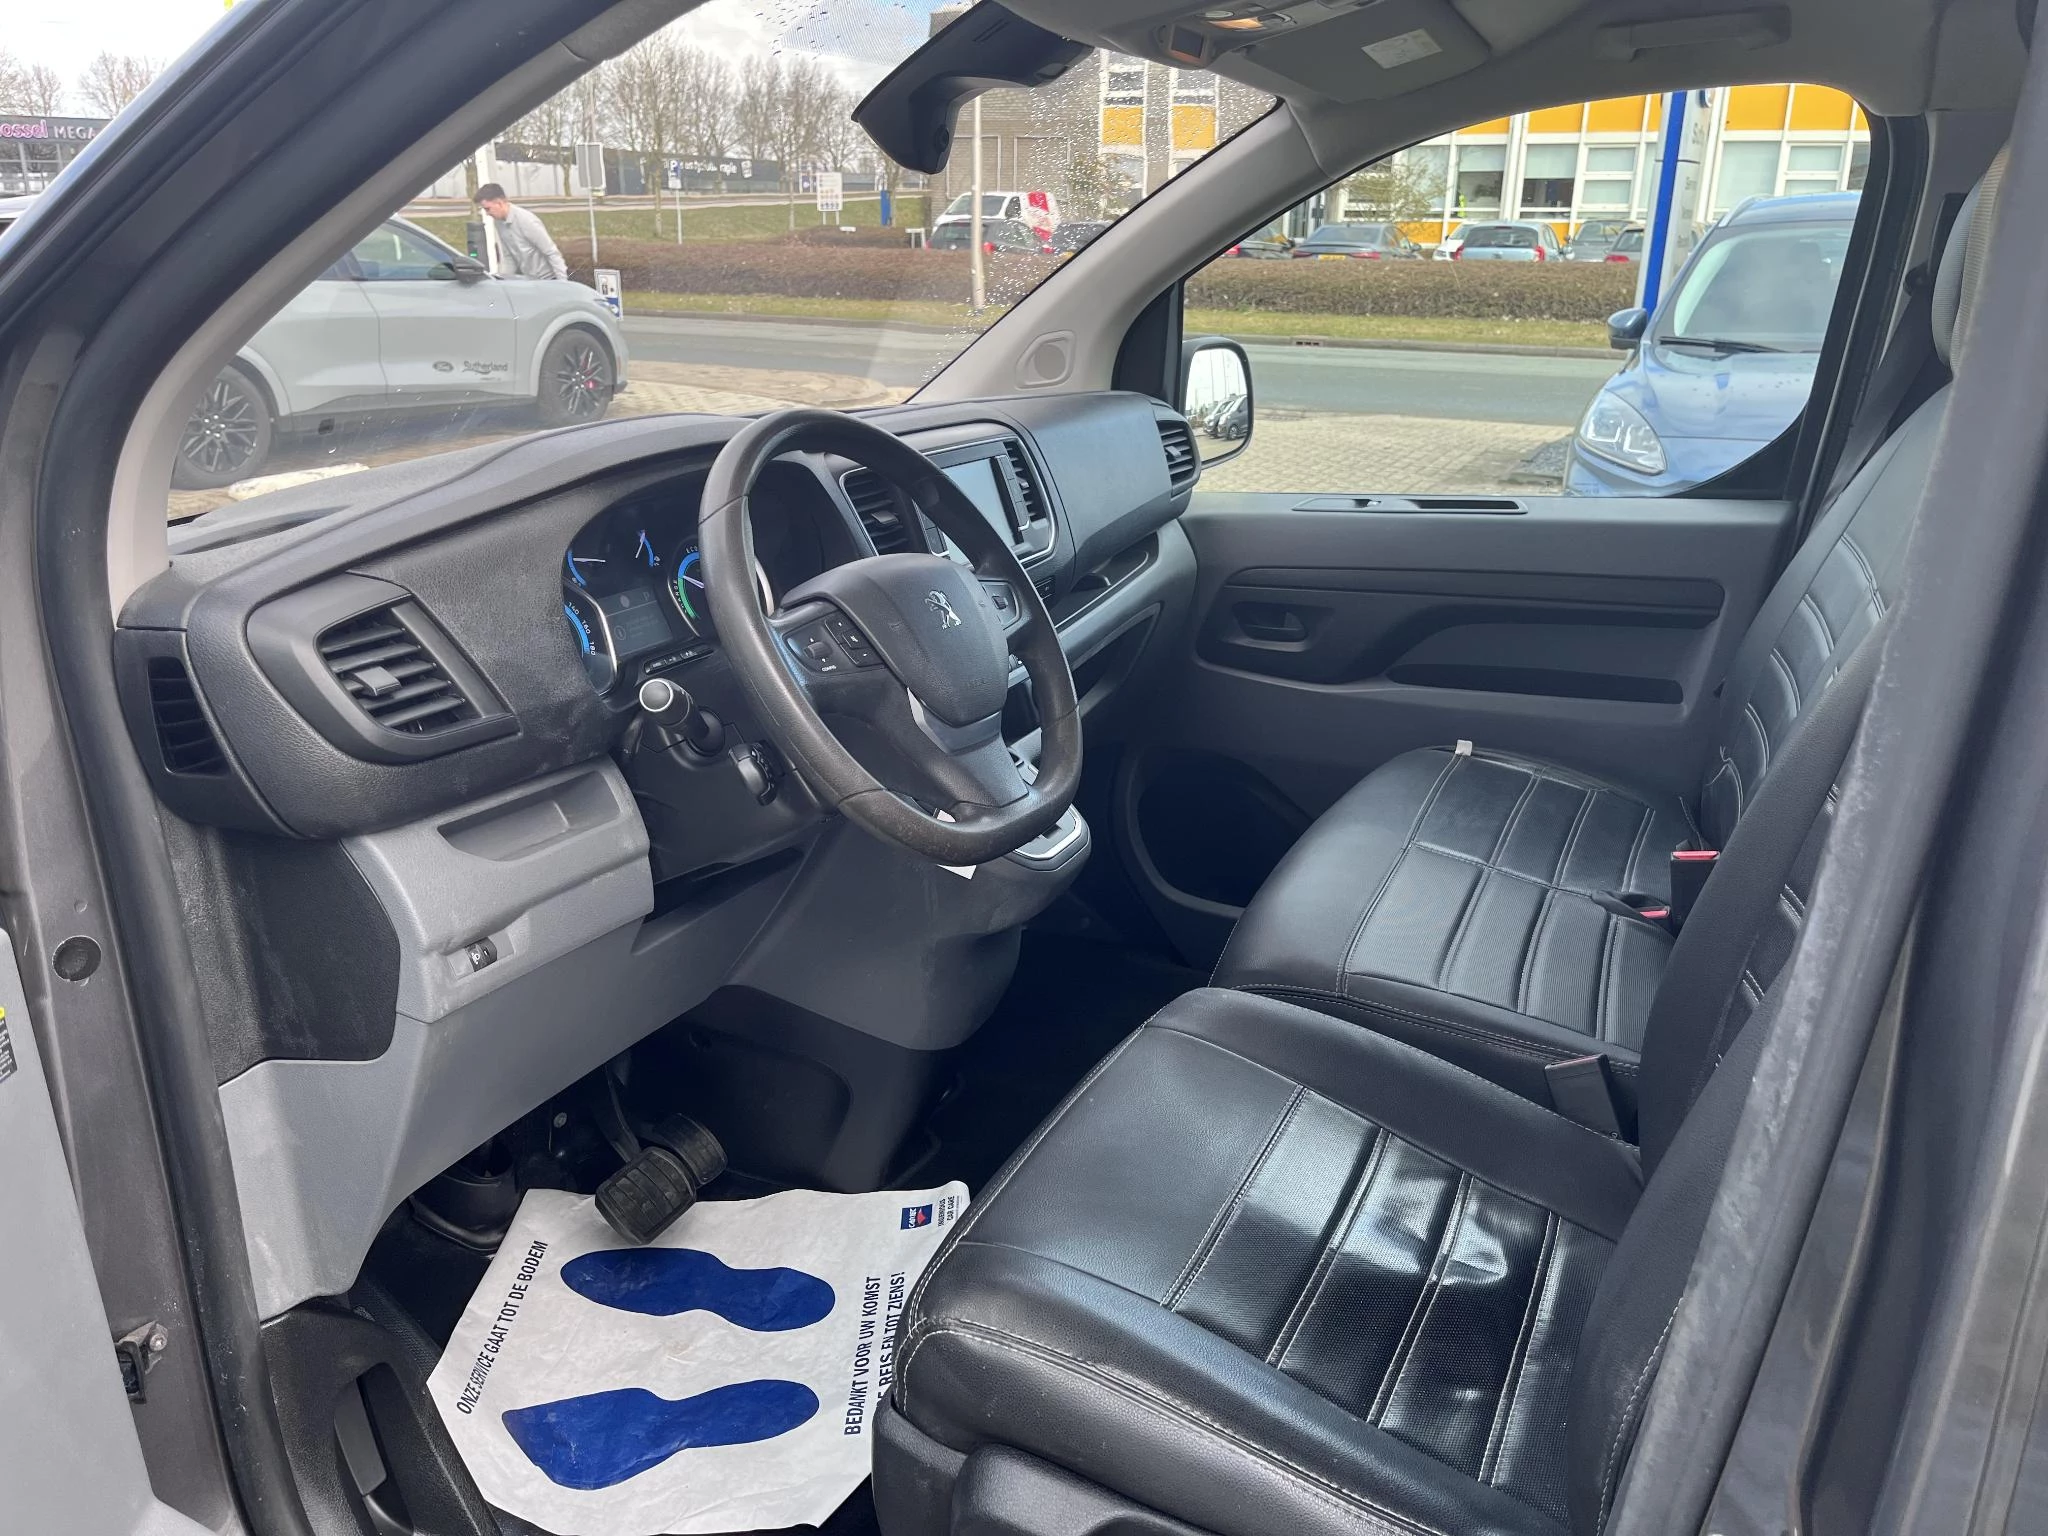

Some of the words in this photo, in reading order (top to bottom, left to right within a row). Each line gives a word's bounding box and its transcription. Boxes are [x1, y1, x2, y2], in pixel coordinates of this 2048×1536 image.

[569, 601, 580, 615] 140
[582, 620, 591, 634] 160
[517, 1240, 549, 1282] BODEM
[508, 1283, 529, 1301] DE
[862, 1276, 881, 1318] KOMST
[887, 1271, 905, 1312] ZIENS!
[497, 1301, 520, 1322] TOT
[884, 1313, 900, 1337] TOT
[484, 1324, 509, 1354] GAAT
[859, 1320, 876, 1340] UW
[469, 1351, 496, 1389] SERVICE
[853, 1341, 873, 1377] VOOR
[456, 1383, 482, 1415] ONZE
[844, 1380, 869, 1436] BEDANKT
